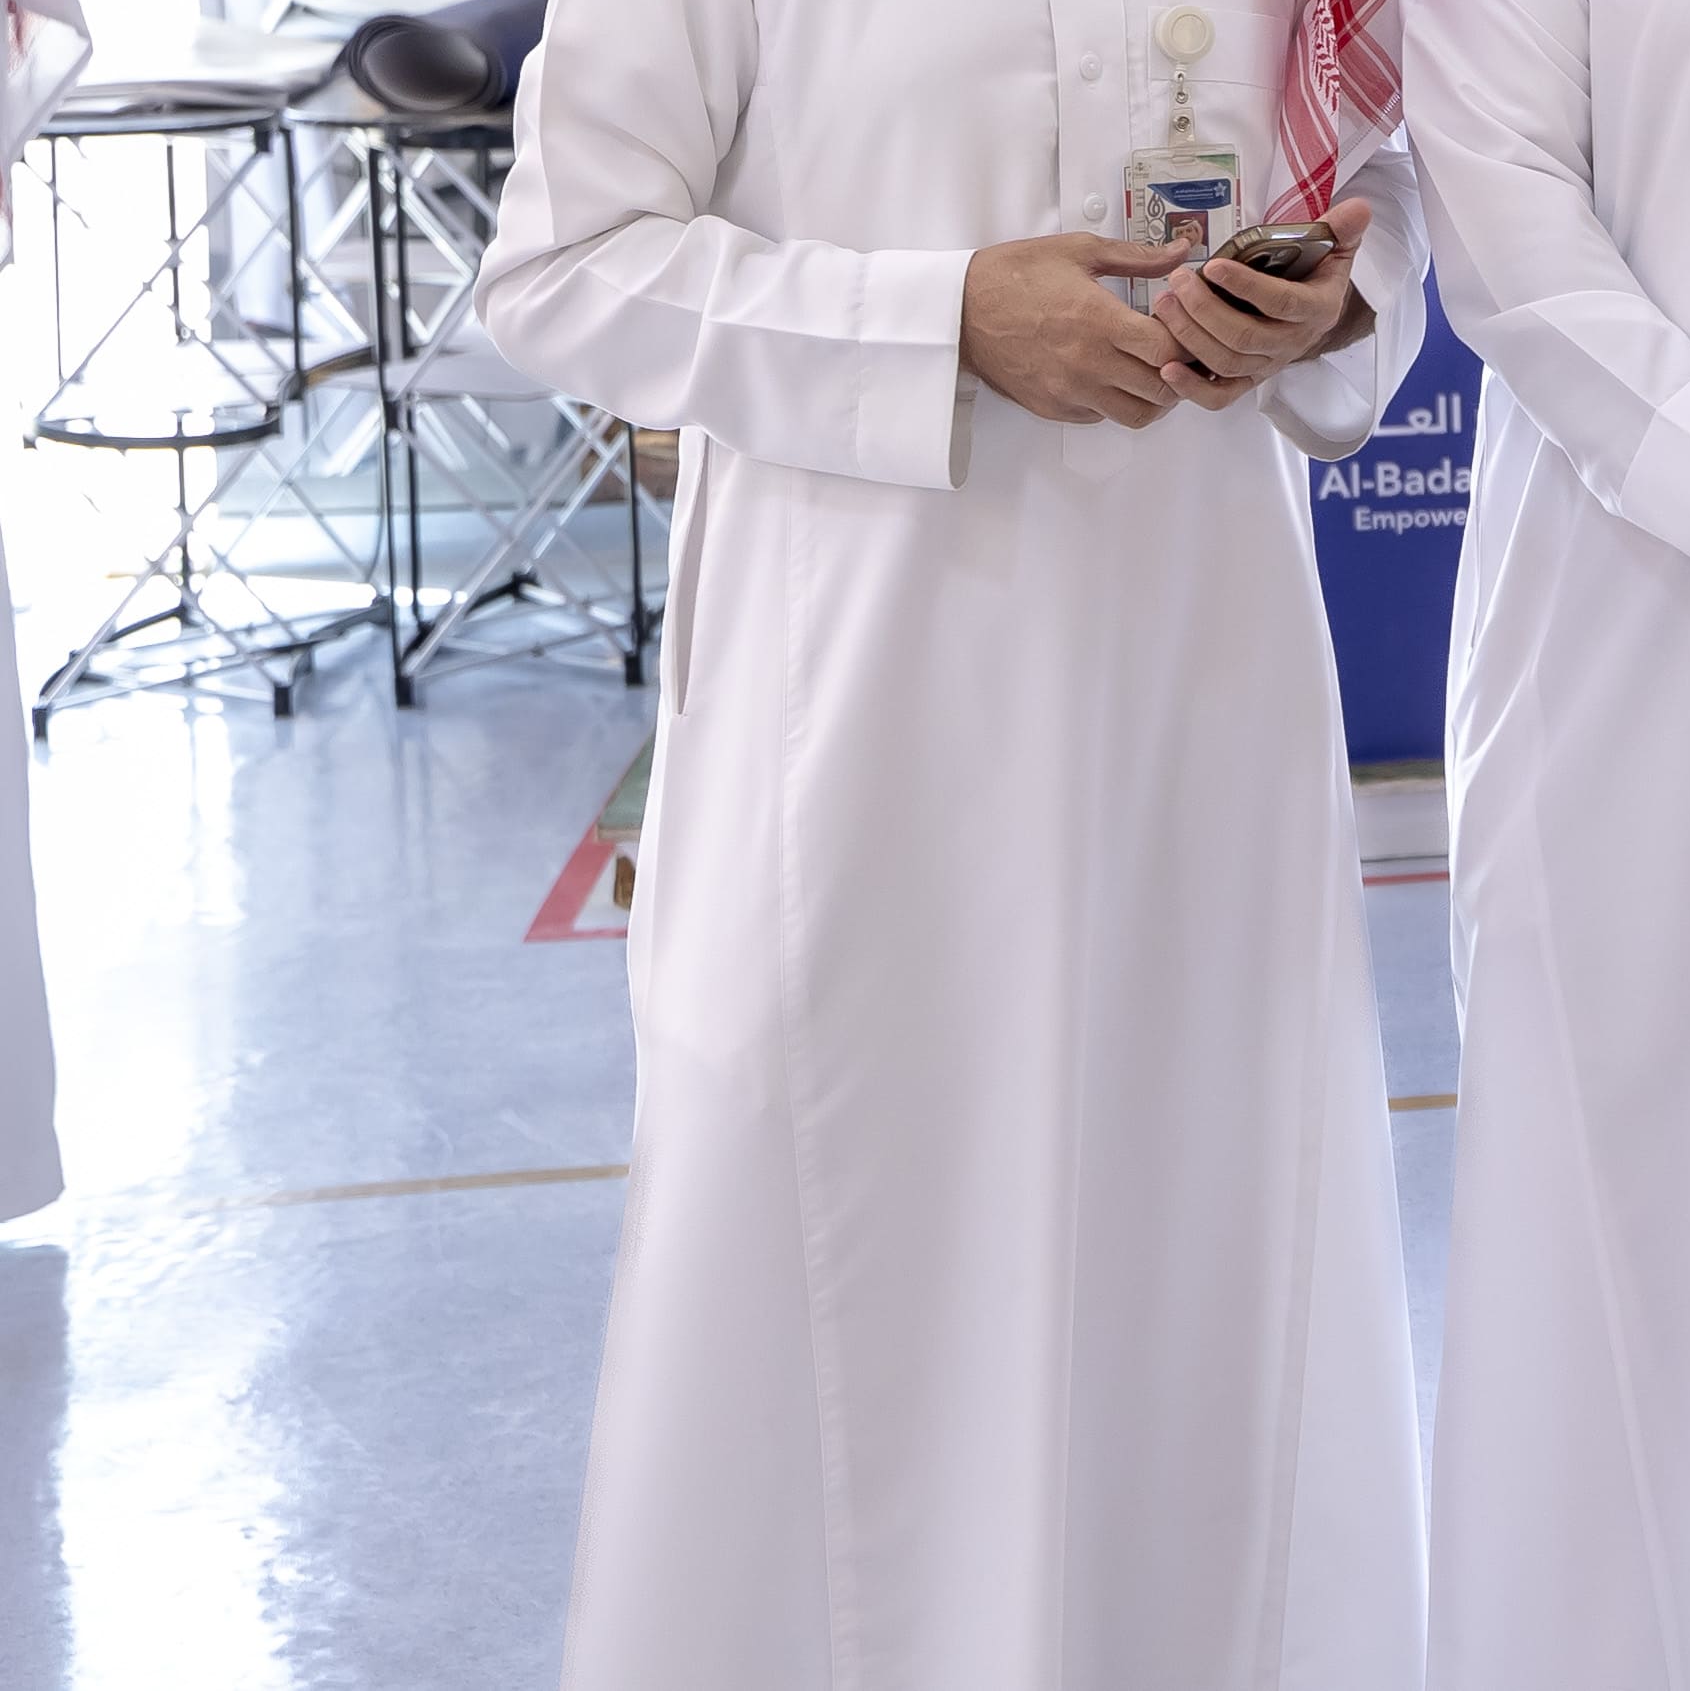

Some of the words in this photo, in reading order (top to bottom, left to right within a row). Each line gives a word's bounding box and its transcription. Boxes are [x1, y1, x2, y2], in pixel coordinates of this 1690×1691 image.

[1372, 391, 1463, 439] الع
[1318, 457, 1472, 501] Al-Bada
[1353, 505, 1468, 535] Empowe
